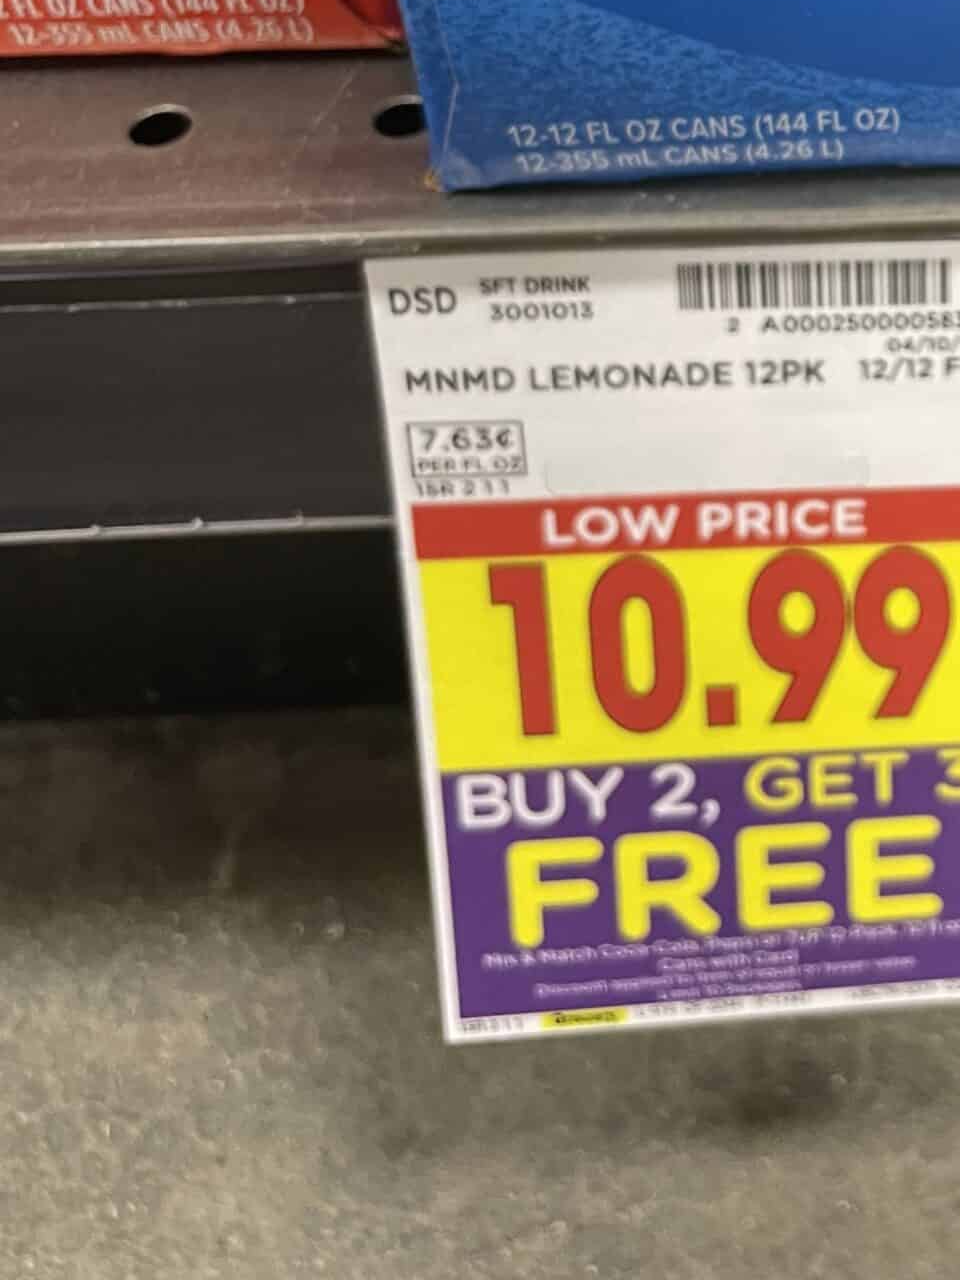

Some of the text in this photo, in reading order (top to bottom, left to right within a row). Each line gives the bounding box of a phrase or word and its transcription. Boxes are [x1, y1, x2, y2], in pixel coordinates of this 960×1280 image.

[143, 19, 209, 44] CANS
[508, 107, 900, 148] 12-12 FL OZ CANS (144 FL OZ)
[515, 151, 608, 175] 12-355
[617, 148, 655, 168] mL
[664, 144, 738, 166] CANS
[820, 138, 845, 161] L)
[388, 286, 457, 316] DSD
[480, 275, 590, 296] SFT DRINK
[490, 301, 594, 321] 3001013
[405, 368, 517, 394] MNMD
[529, 361, 733, 391] LEMONADE
[744, 359, 825, 386] 12PK
[858, 357, 934, 382] 12/12
[541, 499, 867, 547] LOW PRICE
[487, 544, 954, 737] 10.99
[456, 765, 624, 829] BUY
[650, 761, 721, 825] 2,
[744, 751, 910, 811] GET
[505, 814, 945, 949] FREE
